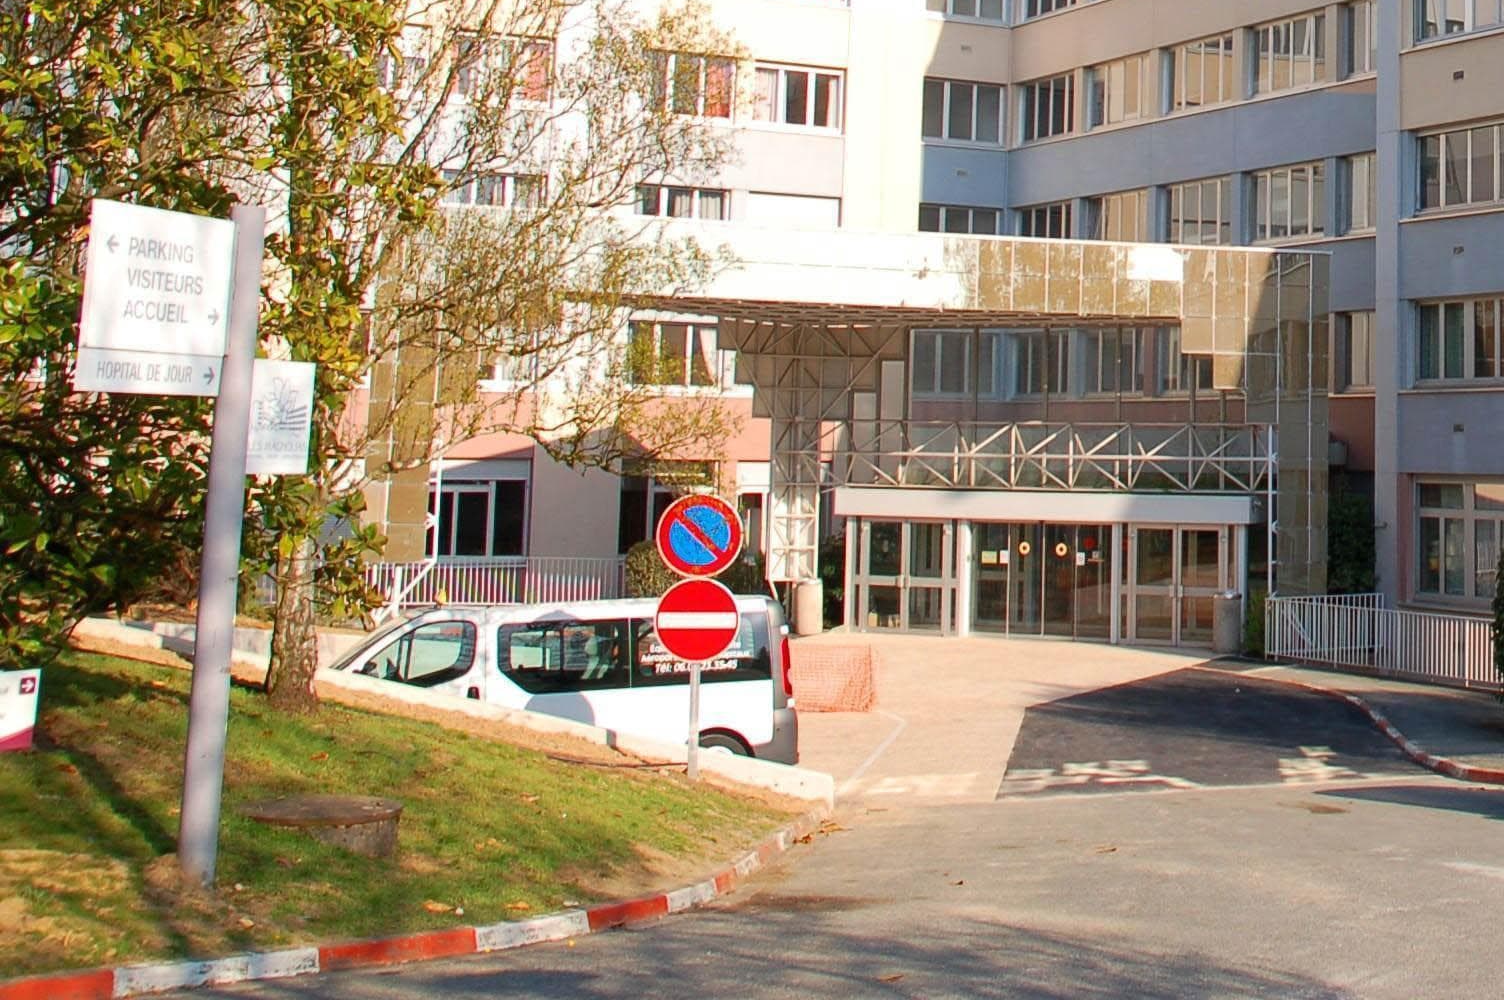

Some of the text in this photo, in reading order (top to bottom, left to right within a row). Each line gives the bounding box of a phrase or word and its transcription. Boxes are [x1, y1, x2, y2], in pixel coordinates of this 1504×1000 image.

[128, 236, 194, 264] PARKING
[127, 268, 204, 296] VISITEURS
[123, 300, 189, 324] ACCUEIL
[96, 360, 193, 384] HOPITAL DE JOUR
